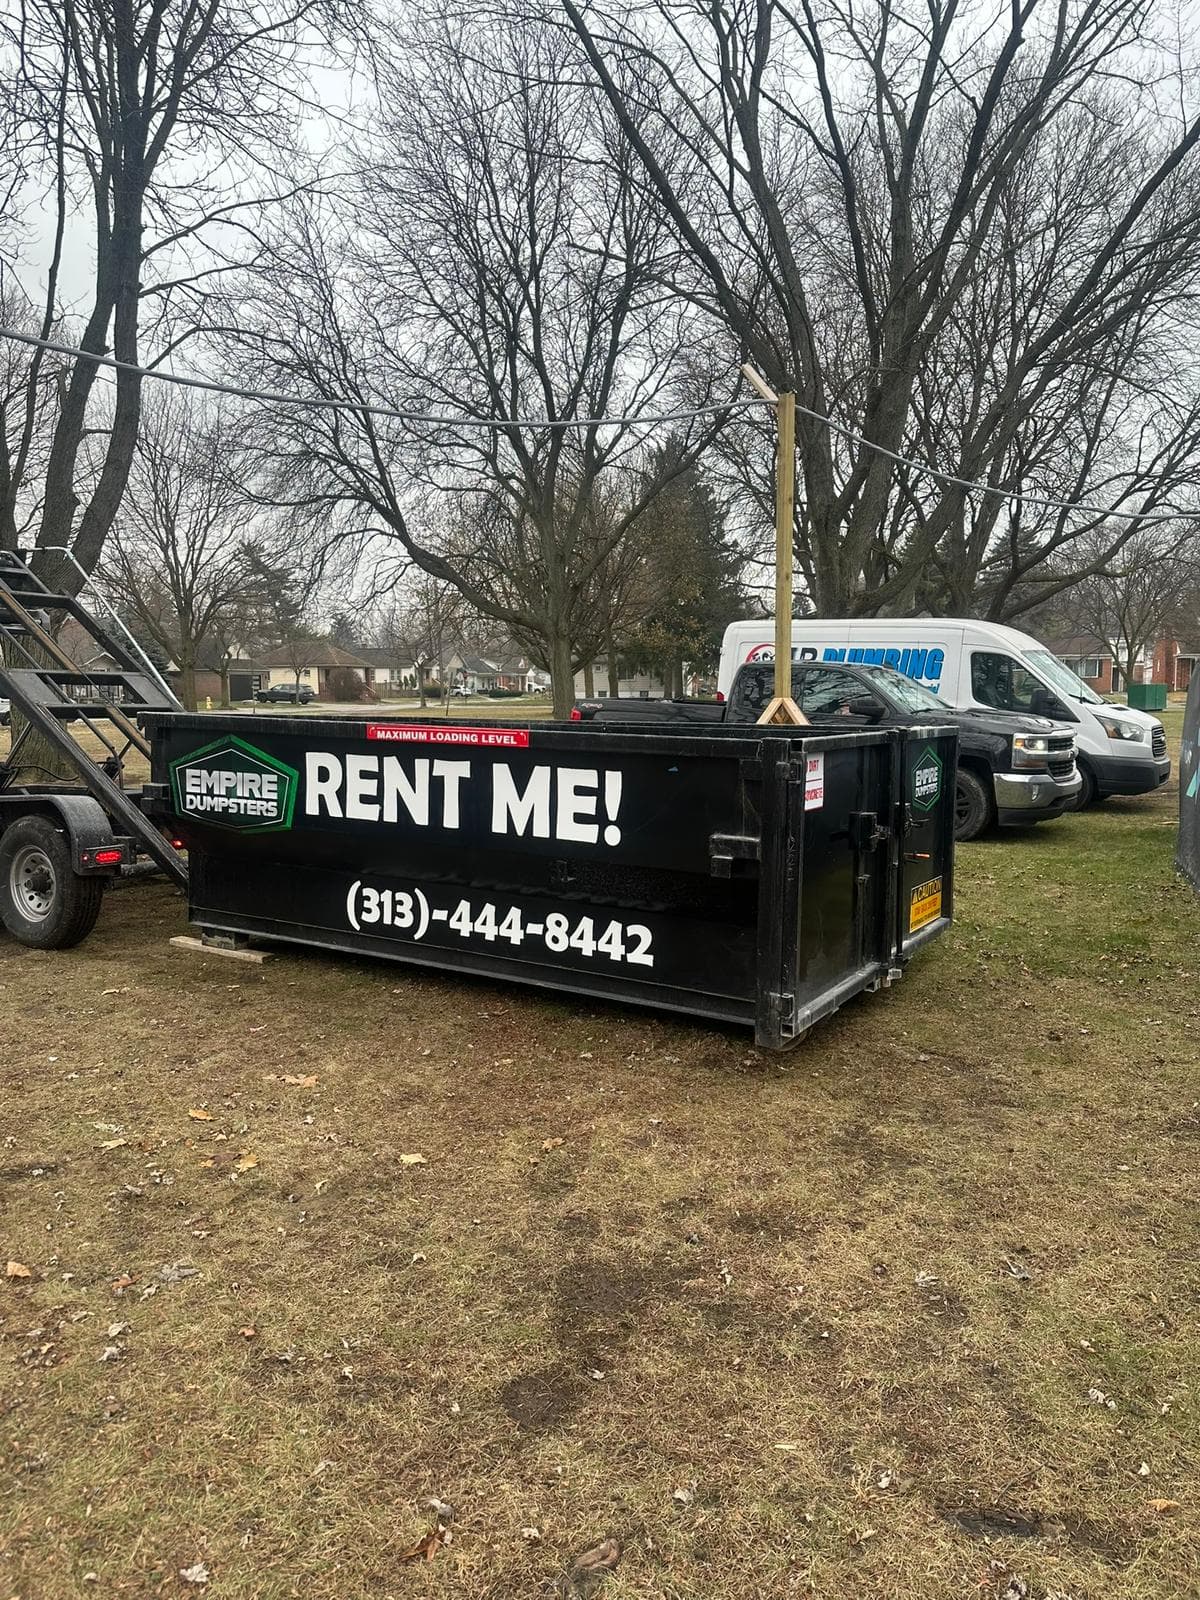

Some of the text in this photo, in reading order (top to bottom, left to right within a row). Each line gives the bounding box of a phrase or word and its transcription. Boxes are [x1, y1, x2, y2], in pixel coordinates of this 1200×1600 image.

[376, 731, 517, 744] MAXIMUM LOADING LEVEL
[186, 769, 278, 800] EMPIRE
[915, 767, 939, 786] EMPIRE
[305, 752, 623, 847] RENT ME!
[915, 782, 938, 798] DUMPSTERS
[186, 794, 278, 817] DUMPSTERS
[346, 880, 654, 967] (313)-444-8442
